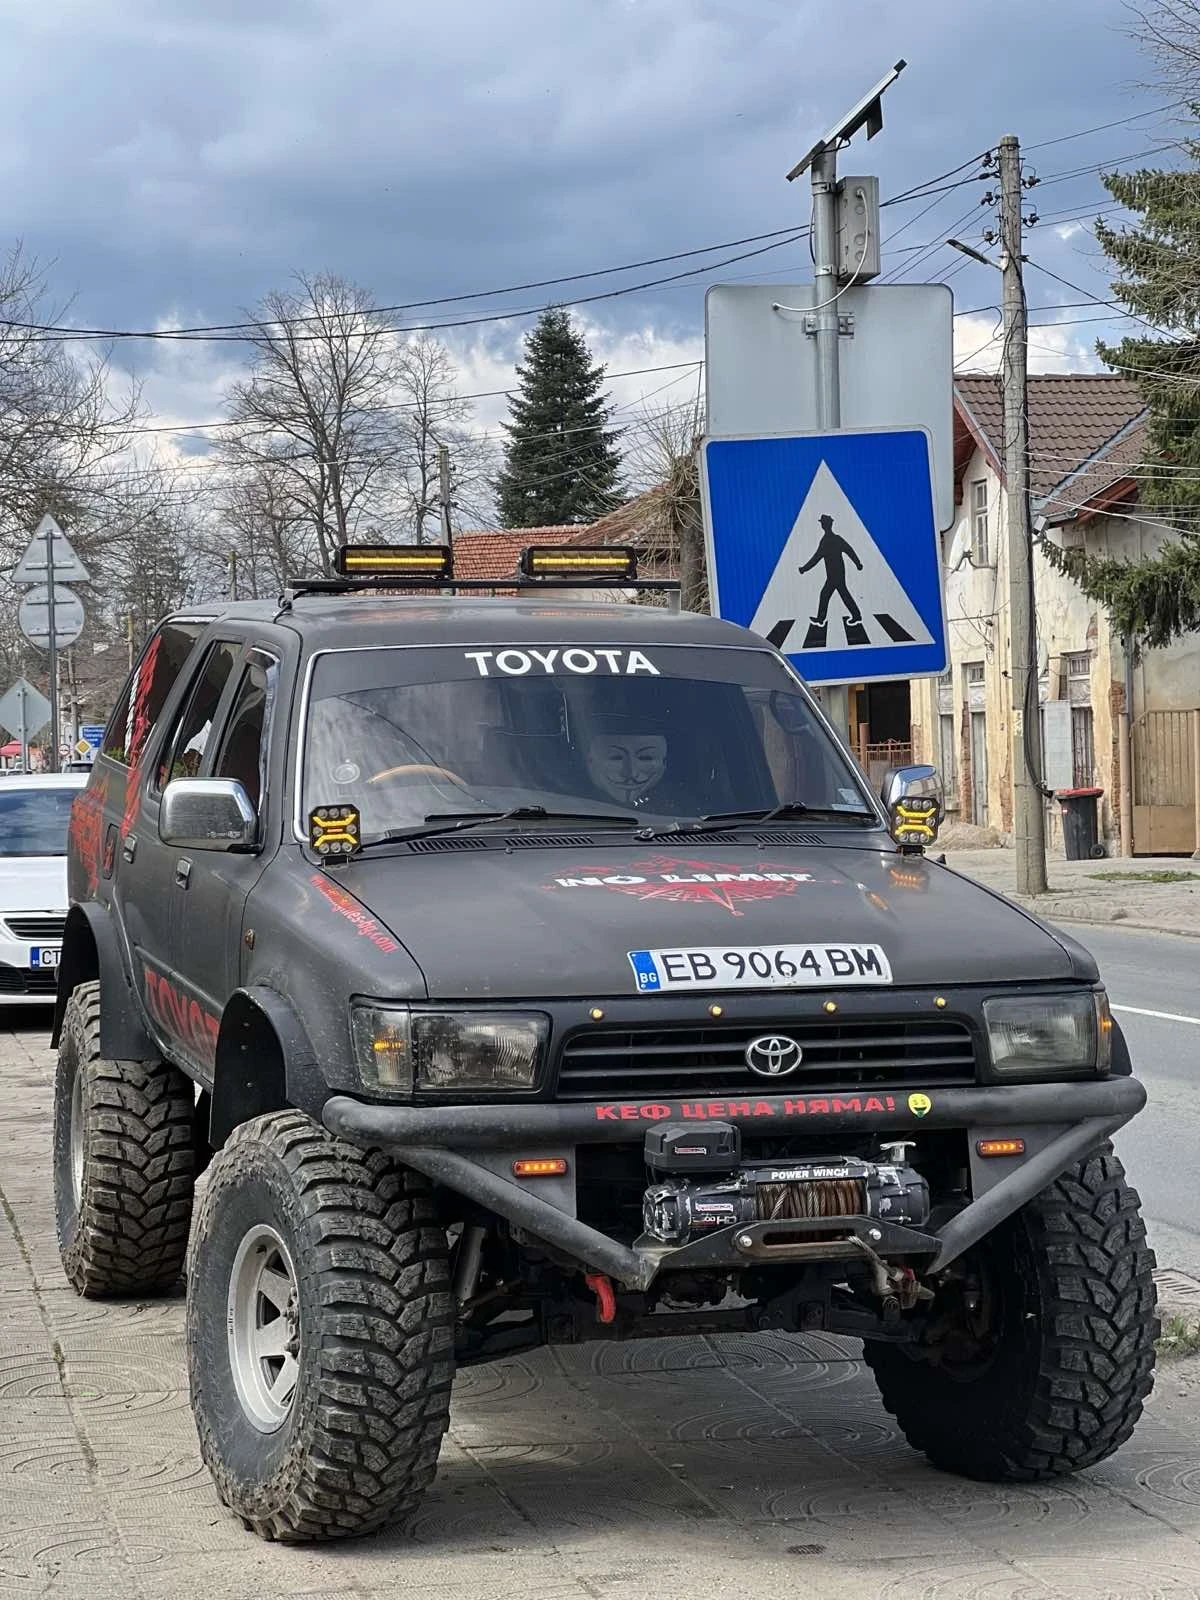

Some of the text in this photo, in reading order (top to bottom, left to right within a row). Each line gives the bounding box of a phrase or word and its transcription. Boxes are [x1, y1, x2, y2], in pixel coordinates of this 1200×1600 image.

[464, 648, 661, 676] TOYOTA
[554, 872, 816, 888] NO LIMIT
[42, 950, 62, 965] CT
[659, 948, 883, 982] EB 9064 BM
[639, 972, 657, 984] BG
[143, 967, 219, 1067] TOYOT
[595, 1096, 896, 1120] КЕФ ЦЕНА НЯМА!
[771, 1167, 849, 1180] POWER WINCH
